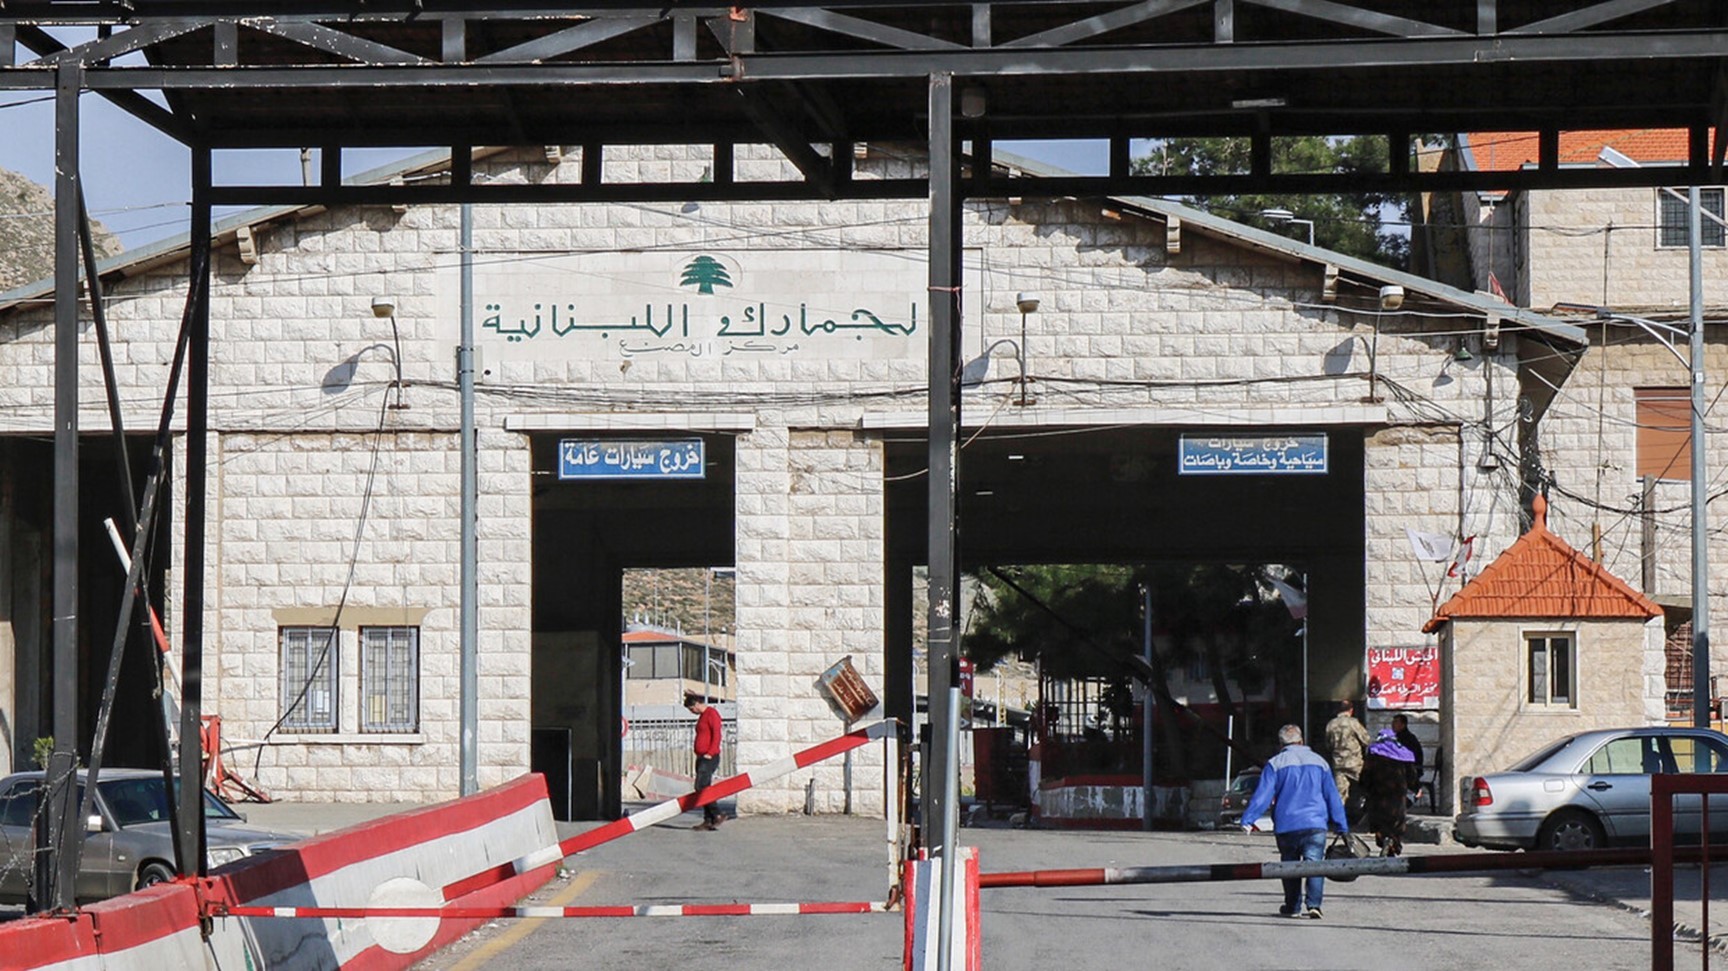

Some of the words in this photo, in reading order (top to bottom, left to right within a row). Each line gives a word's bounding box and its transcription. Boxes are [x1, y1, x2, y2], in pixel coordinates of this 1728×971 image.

[482, 303, 688, 343] اللبنانية
[717, 302, 916, 341] لجمارك
[619, 339, 712, 358] المصنع
[722, 340, 800, 356] مركز
[1262, 437, 1299, 451] خروج
[659, 443, 700, 474] خروج
[1371, 648, 1407, 668] اللبناني
[1405, 647, 1438, 666] الجيش
